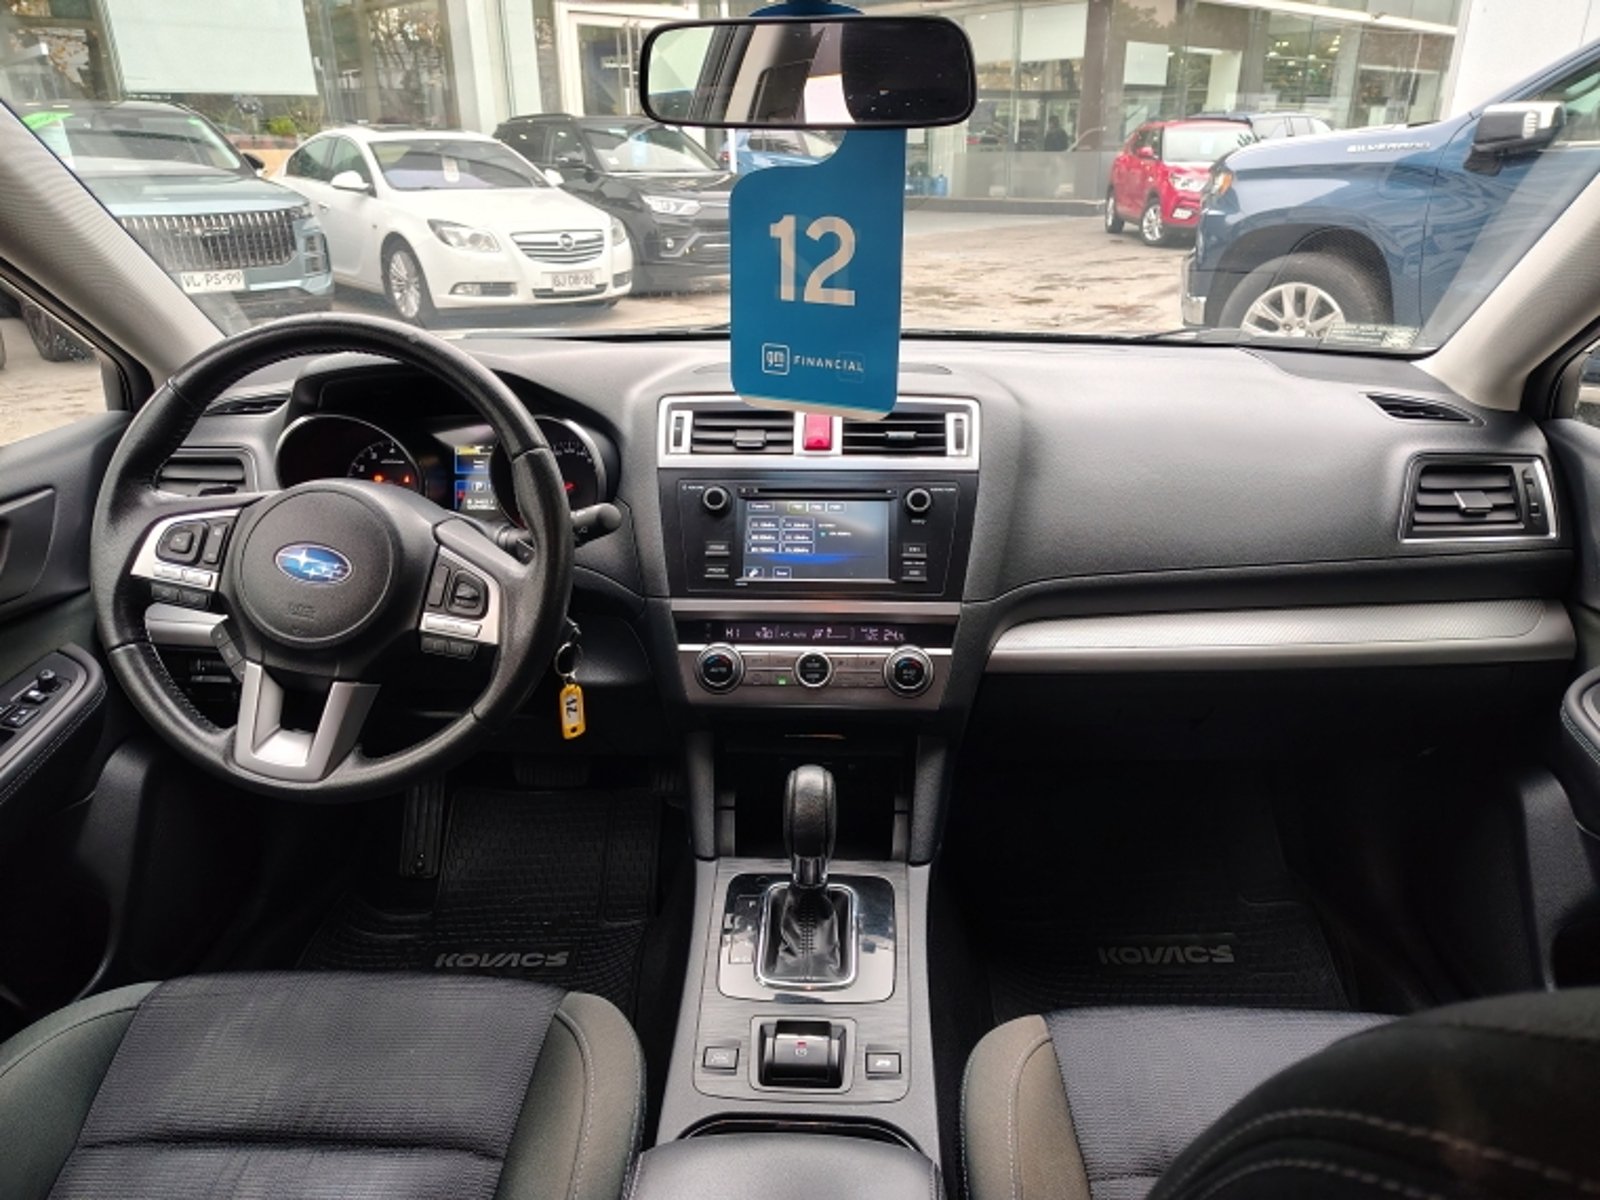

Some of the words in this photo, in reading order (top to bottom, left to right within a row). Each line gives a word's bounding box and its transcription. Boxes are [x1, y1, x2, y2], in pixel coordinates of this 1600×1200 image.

[769, 214, 856, 306] 12
[792, 355, 864, 372] FINANCIAL
[434, 951, 570, 968] KOVACS
[1098, 944, 1234, 965] KOVACS
